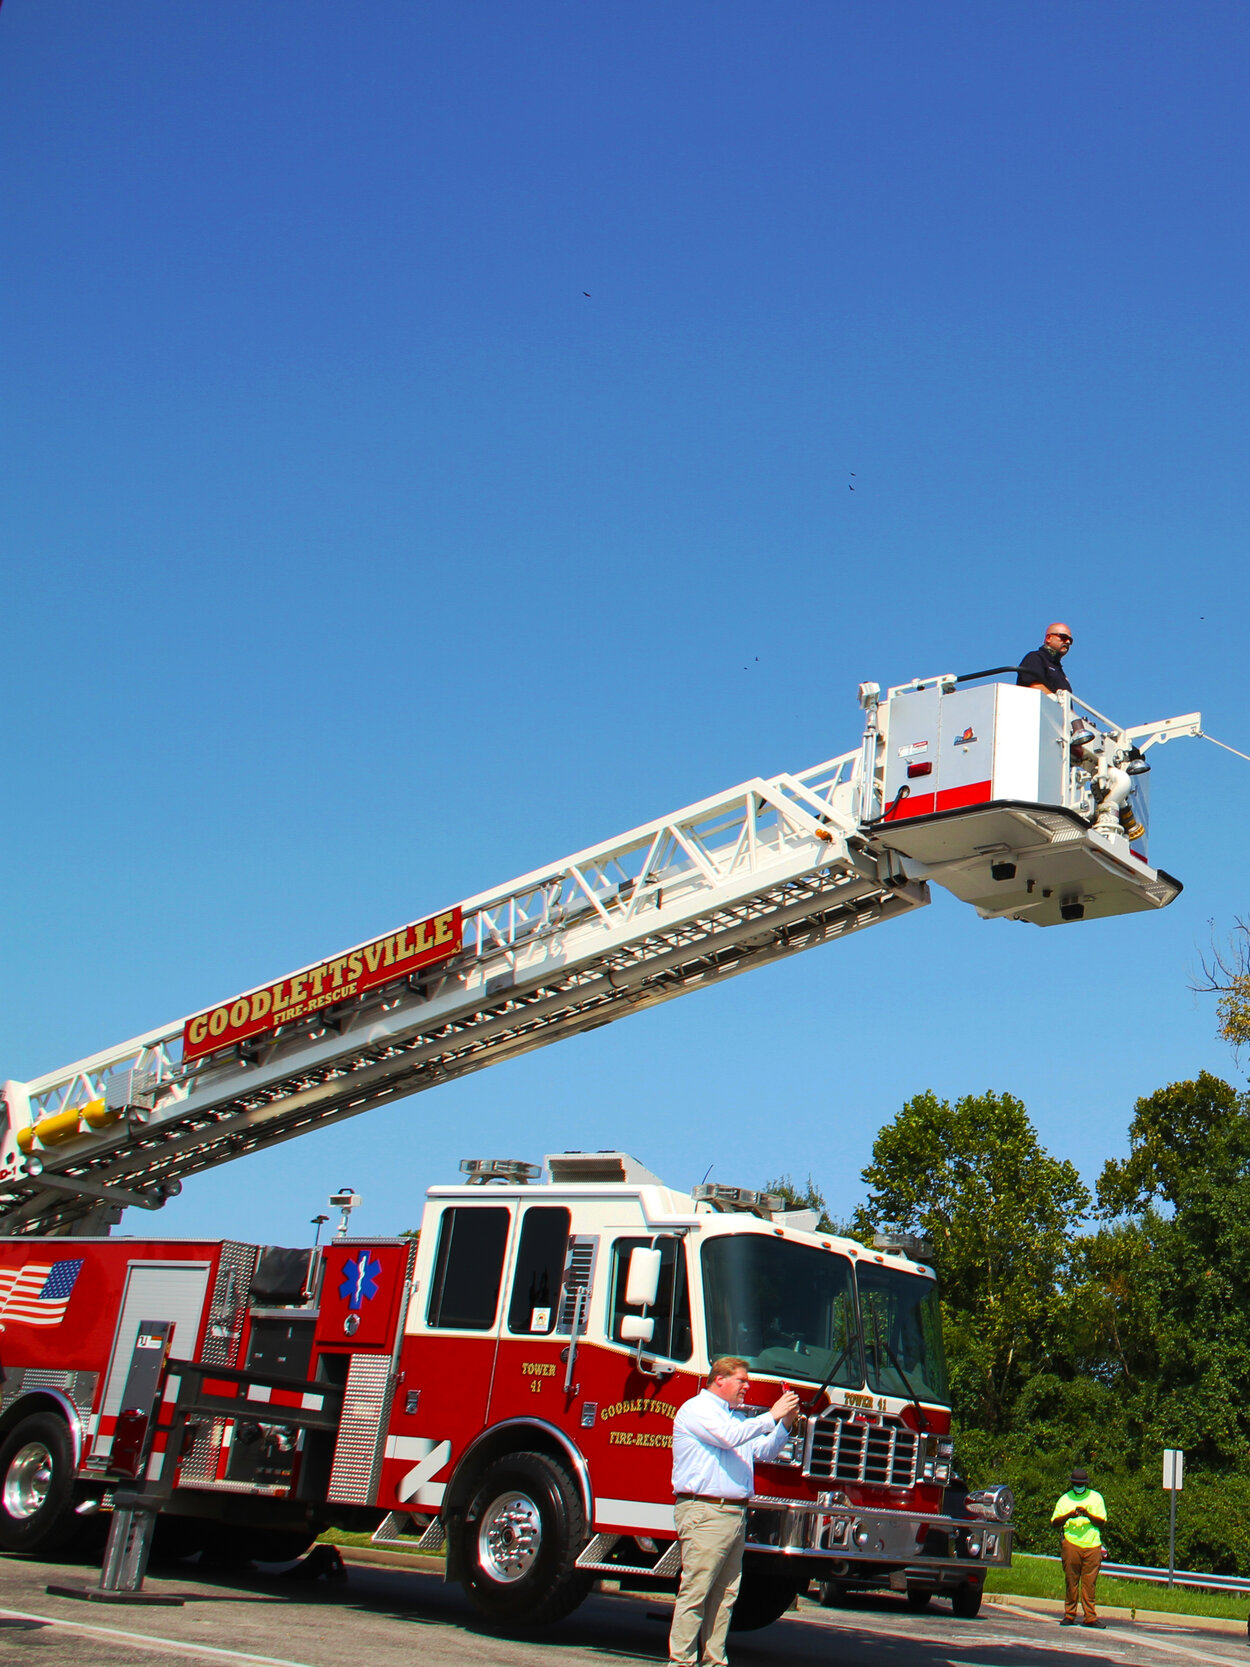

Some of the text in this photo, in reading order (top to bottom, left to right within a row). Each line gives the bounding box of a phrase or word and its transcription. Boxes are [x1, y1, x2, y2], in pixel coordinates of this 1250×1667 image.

[188, 911, 454, 1045] GOODLETTSVILLE
[272, 982, 358, 1026] FIRE-RESCUE
[522, 1363, 556, 1376] TOWER
[530, 1380, 542, 1393] 41
[845, 1392, 886, 1411] TOWER 41
